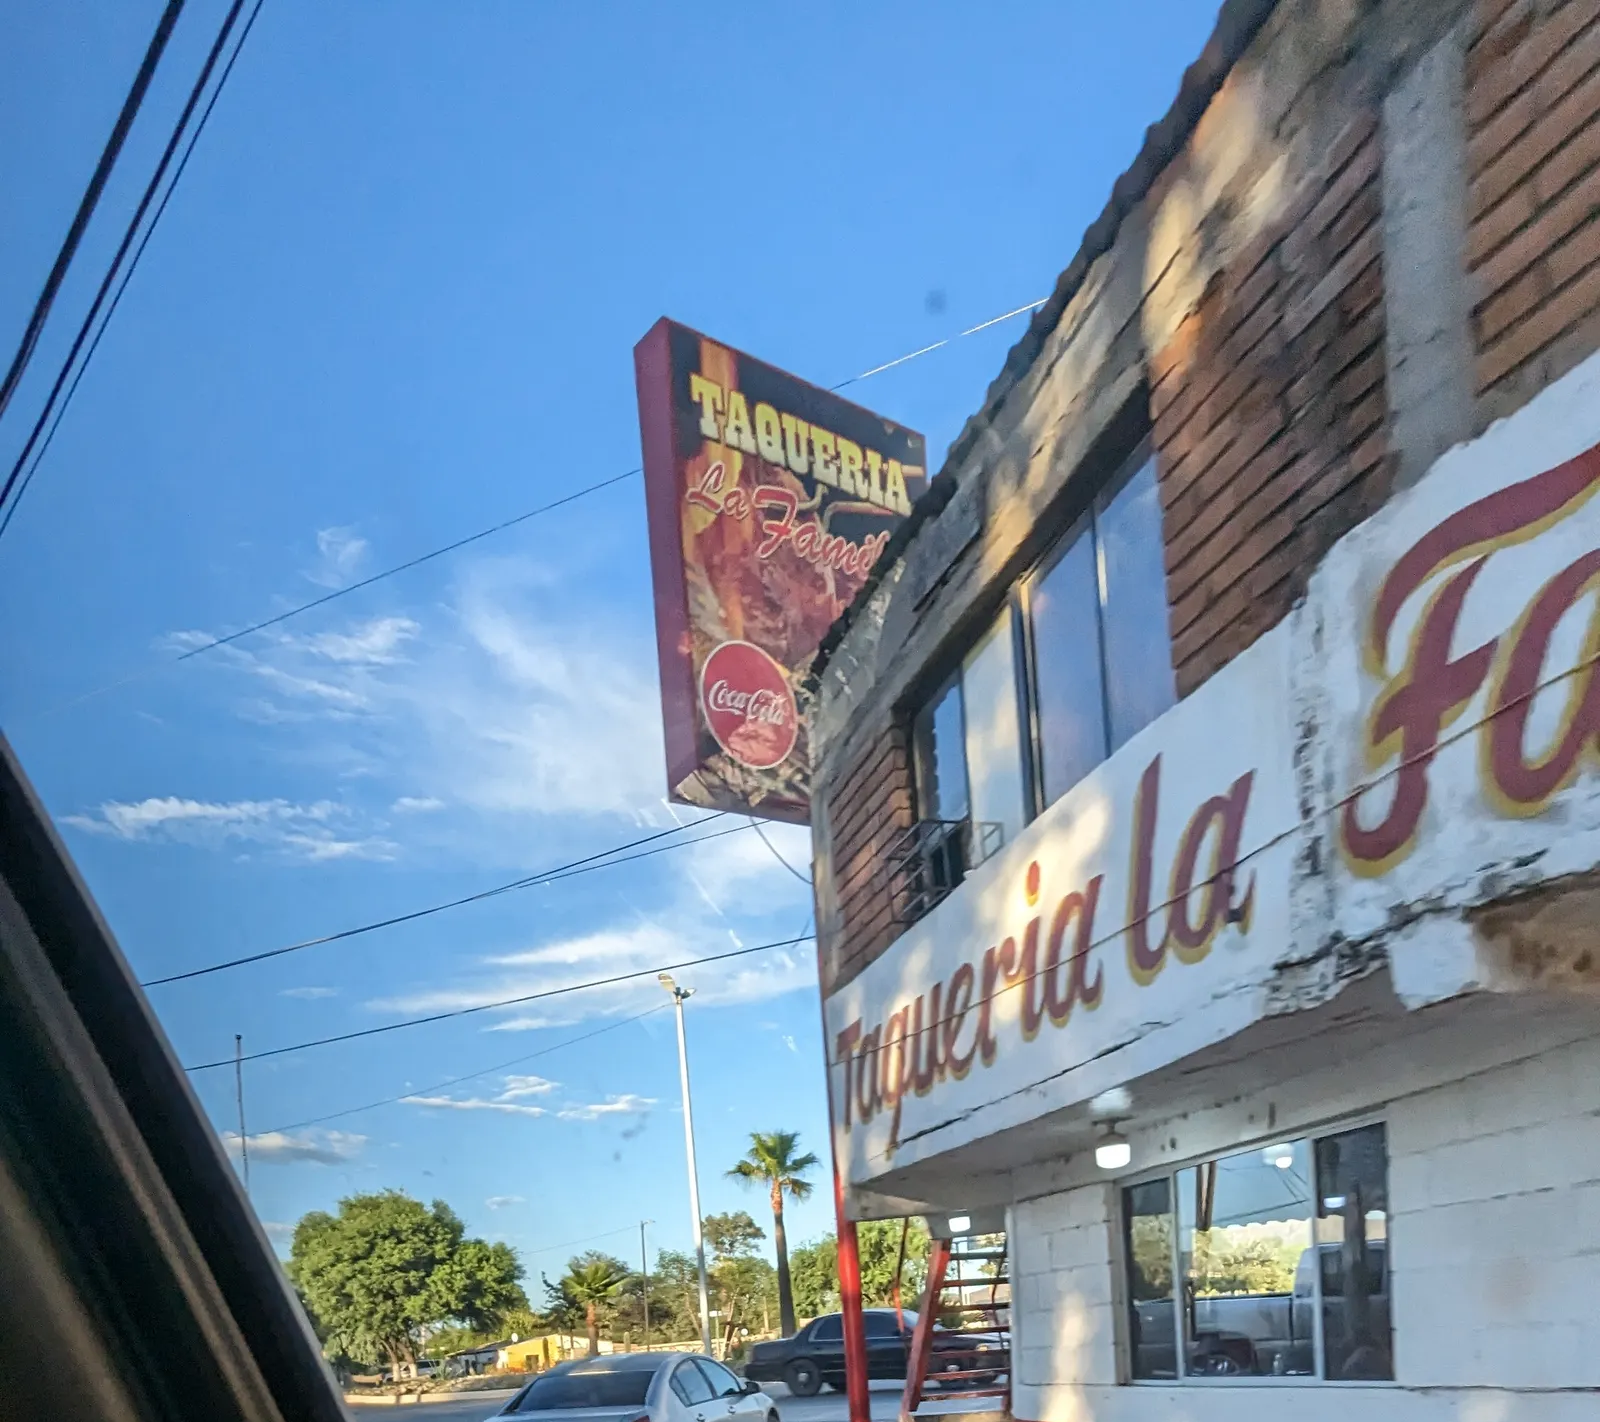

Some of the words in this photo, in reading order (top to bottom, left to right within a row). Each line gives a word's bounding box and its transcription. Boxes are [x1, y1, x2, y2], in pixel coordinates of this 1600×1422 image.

[686, 460, 750, 519] La
[690, 372, 913, 518] TAQUERIA
[836, 859, 1105, 1161] Taqueria
[1126, 752, 1257, 987] la
